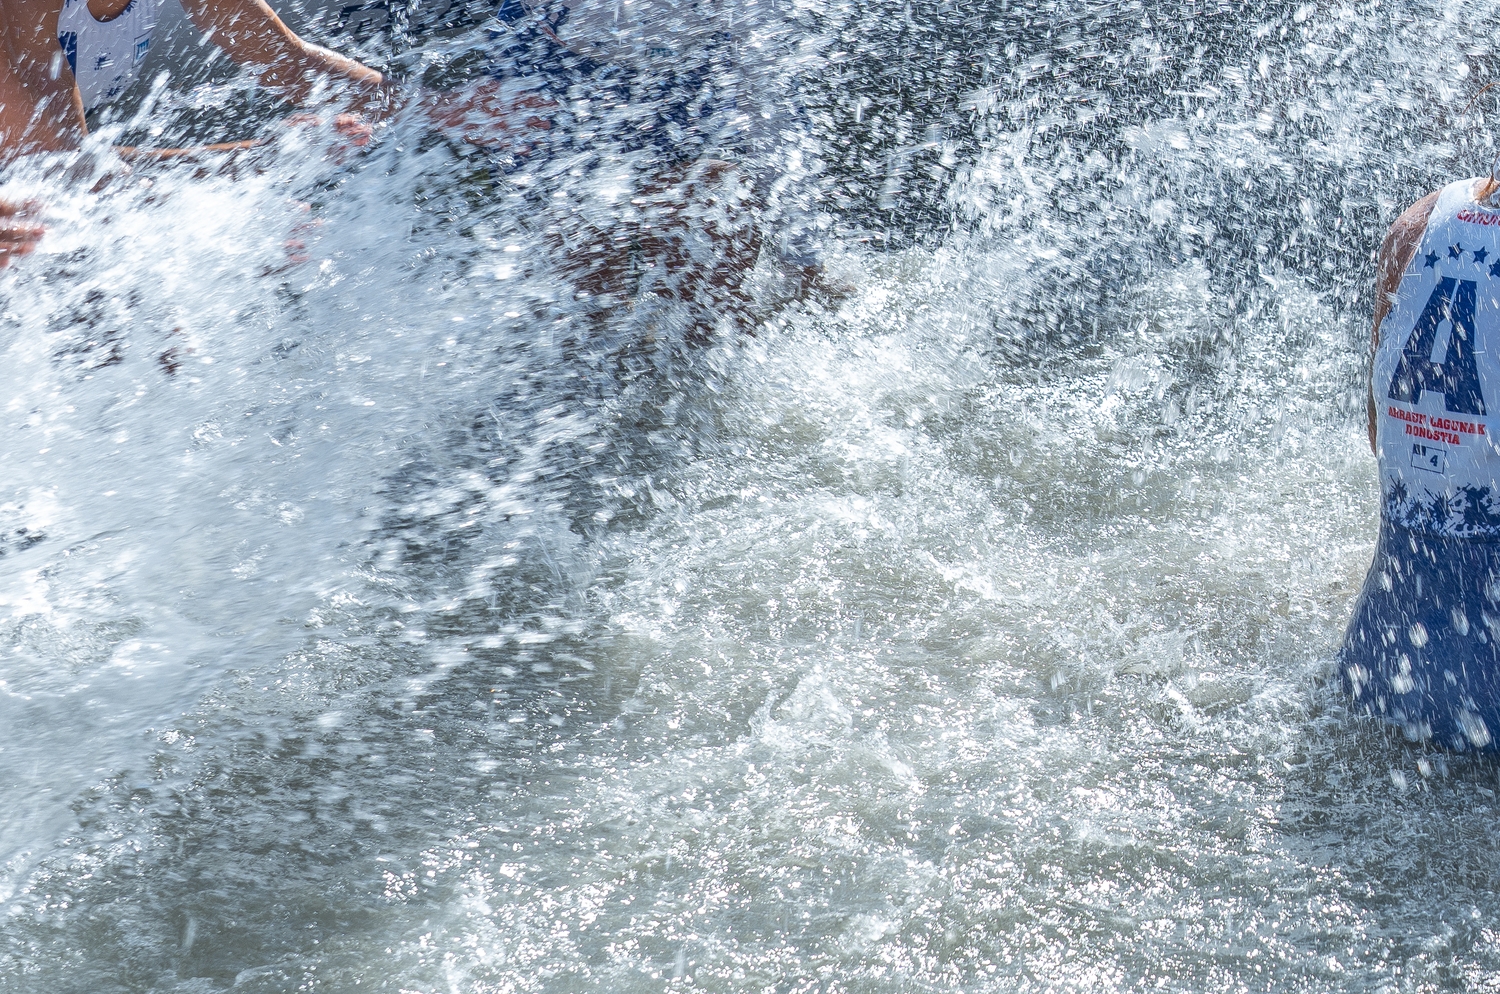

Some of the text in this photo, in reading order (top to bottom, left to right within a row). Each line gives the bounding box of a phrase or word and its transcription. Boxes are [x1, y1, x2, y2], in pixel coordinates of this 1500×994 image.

[1388, 406, 1486, 436] ARRAUN LAGUNAK
[1405, 423, 1461, 446] DONOSTIA
[1429, 454, 1439, 467] 4
